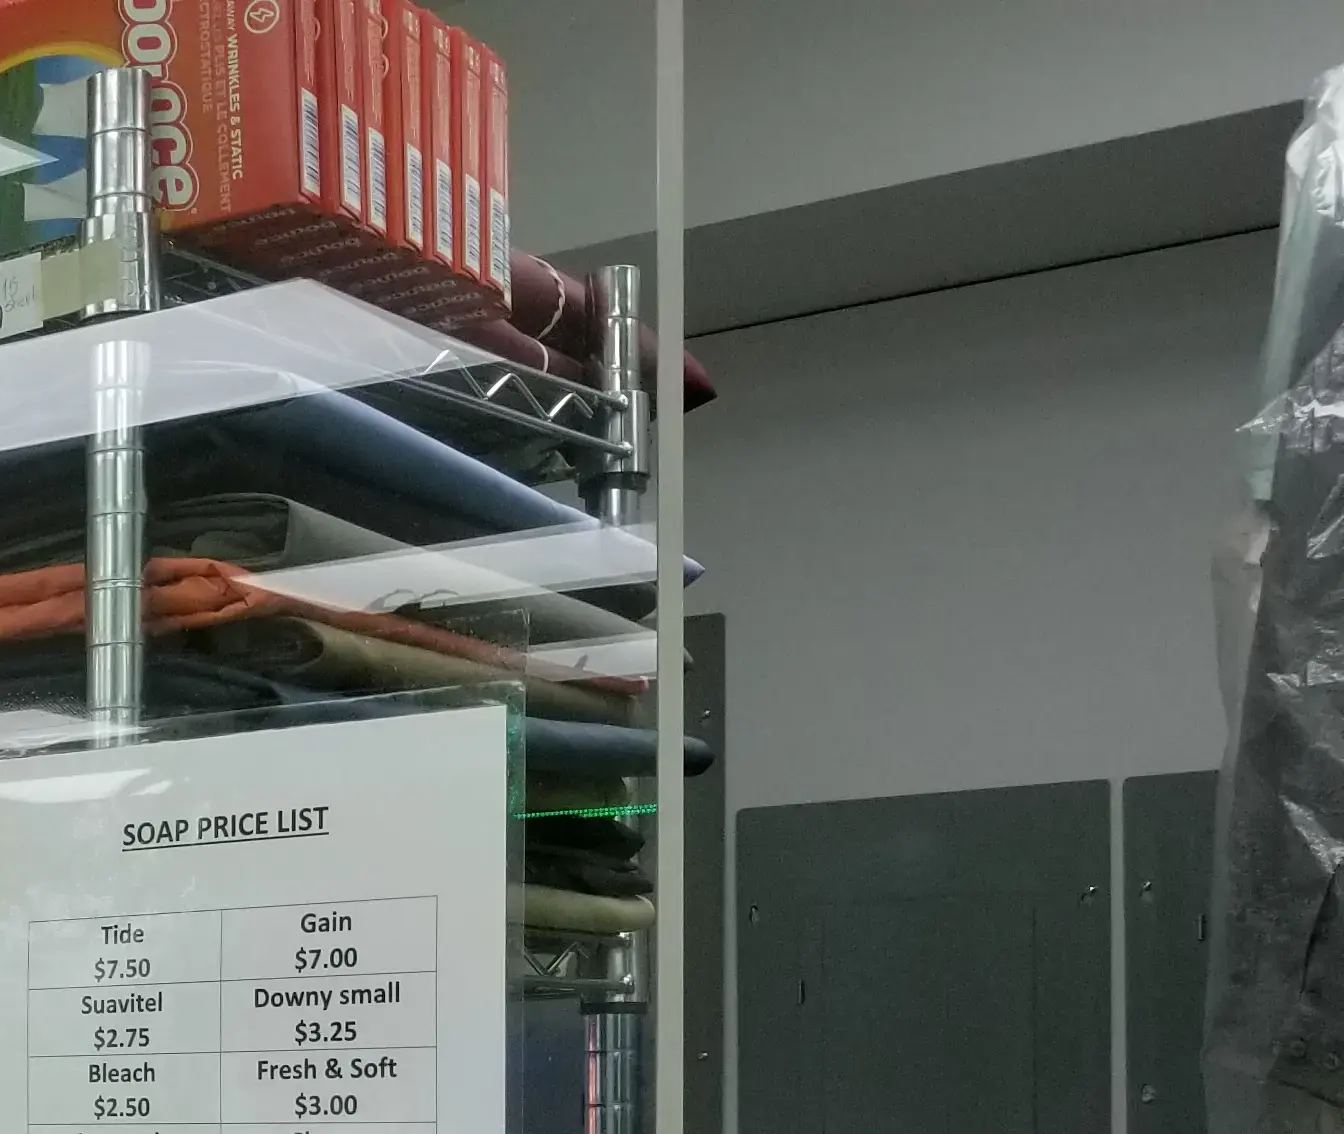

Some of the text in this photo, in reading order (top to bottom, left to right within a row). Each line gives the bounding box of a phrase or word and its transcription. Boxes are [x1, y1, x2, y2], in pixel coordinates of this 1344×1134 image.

[226, 35, 241, 113] WRINKLES
[230, 128, 244, 180] STATIC
[122, 805, 329, 847] SOAP PRICE LIST
[101, 924, 145, 945] Tide
[300, 912, 352, 934] Gain
[94, 957, 151, 981] $7.50
[294, 946, 358, 972] $7.00
[81, 993, 163, 1015] Suavitel
[254, 982, 401, 1011] Downy small
[94, 1027, 150, 1050] $2.75
[294, 1020, 357, 1045] $3.25
[88, 1063, 156, 1083] Bleach
[257, 1058, 398, 1080] Fresh & Soft
[94, 1097, 150, 1119] $2.50
[294, 1094, 357, 1118] $3.00
